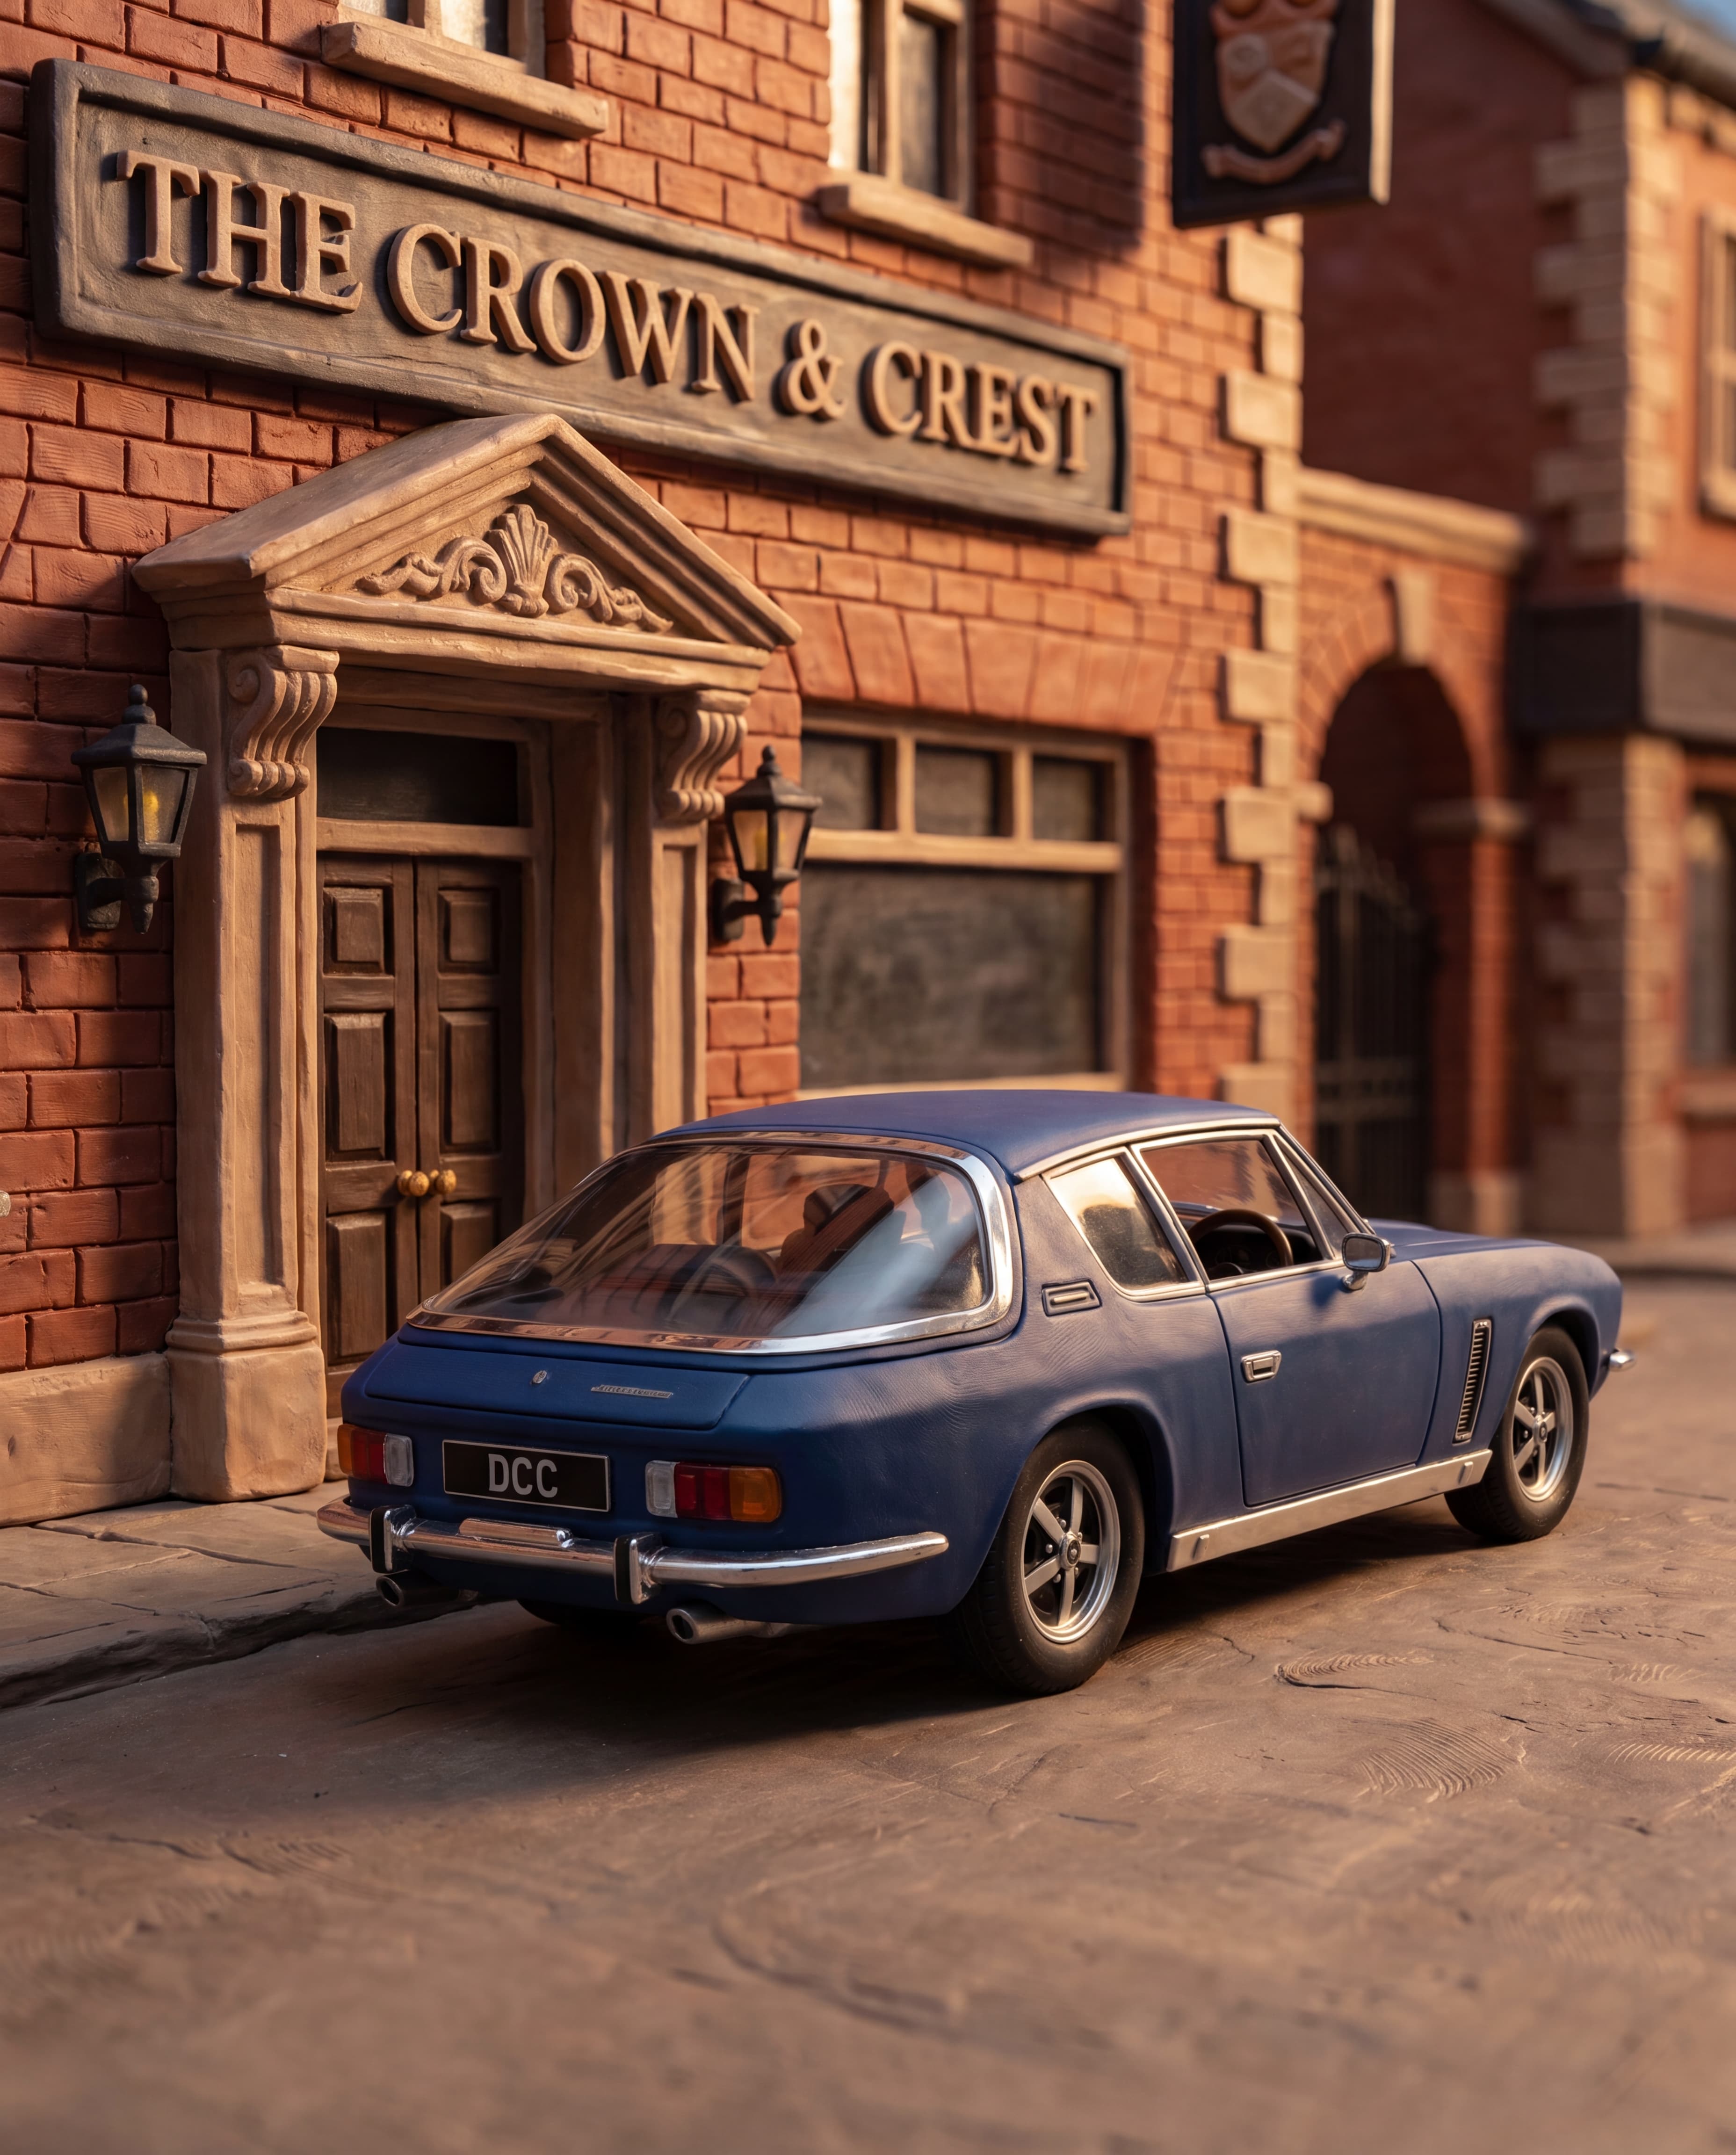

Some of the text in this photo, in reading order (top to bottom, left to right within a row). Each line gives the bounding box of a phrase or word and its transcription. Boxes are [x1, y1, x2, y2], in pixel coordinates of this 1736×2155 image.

[116, 150, 1099, 473] THE CROWN & CREST
[489, 1454, 558, 1497] DCC
